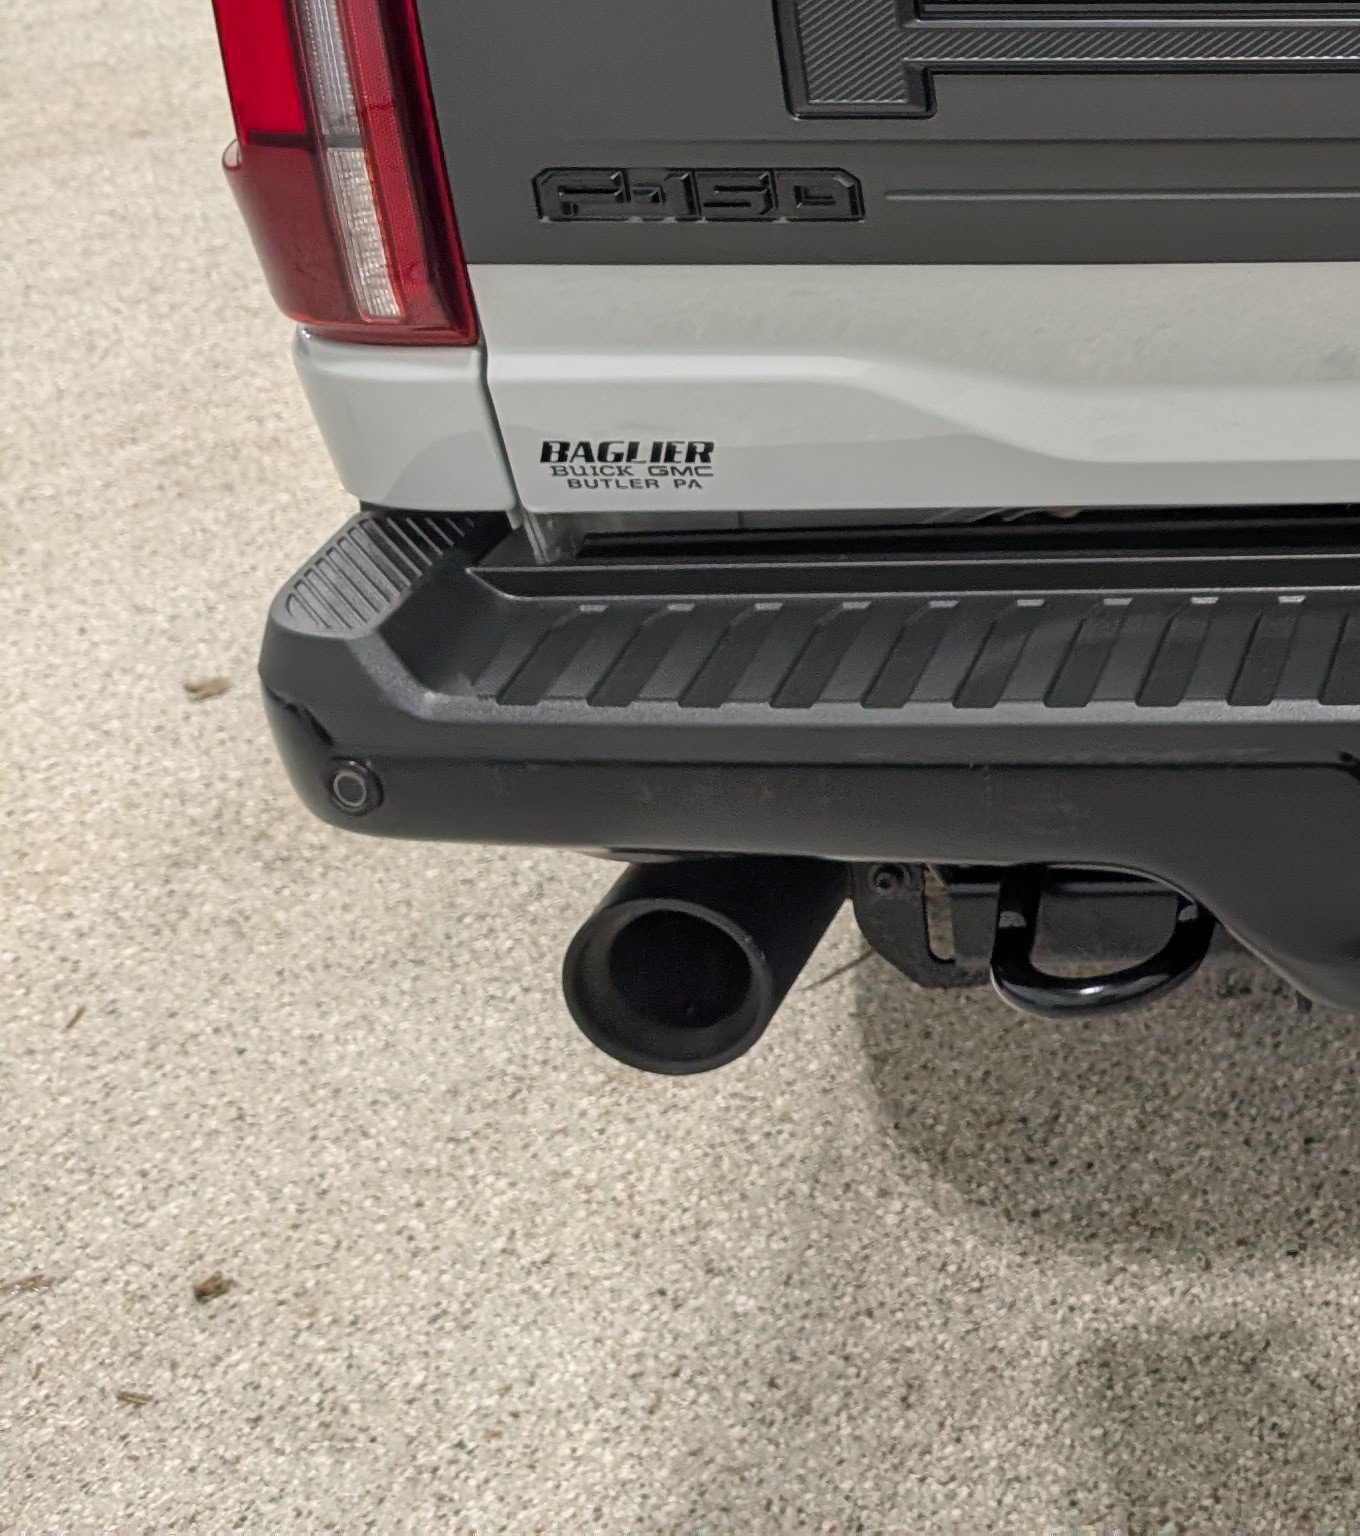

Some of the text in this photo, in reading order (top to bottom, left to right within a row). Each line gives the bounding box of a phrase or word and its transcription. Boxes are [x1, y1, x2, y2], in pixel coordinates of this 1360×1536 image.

[532, 166, 865, 222] F-150
[540, 440, 715, 464] BAGLIER
[550, 465, 714, 477] BUICK GMC
[567, 478, 704, 490] BUTLER PA
